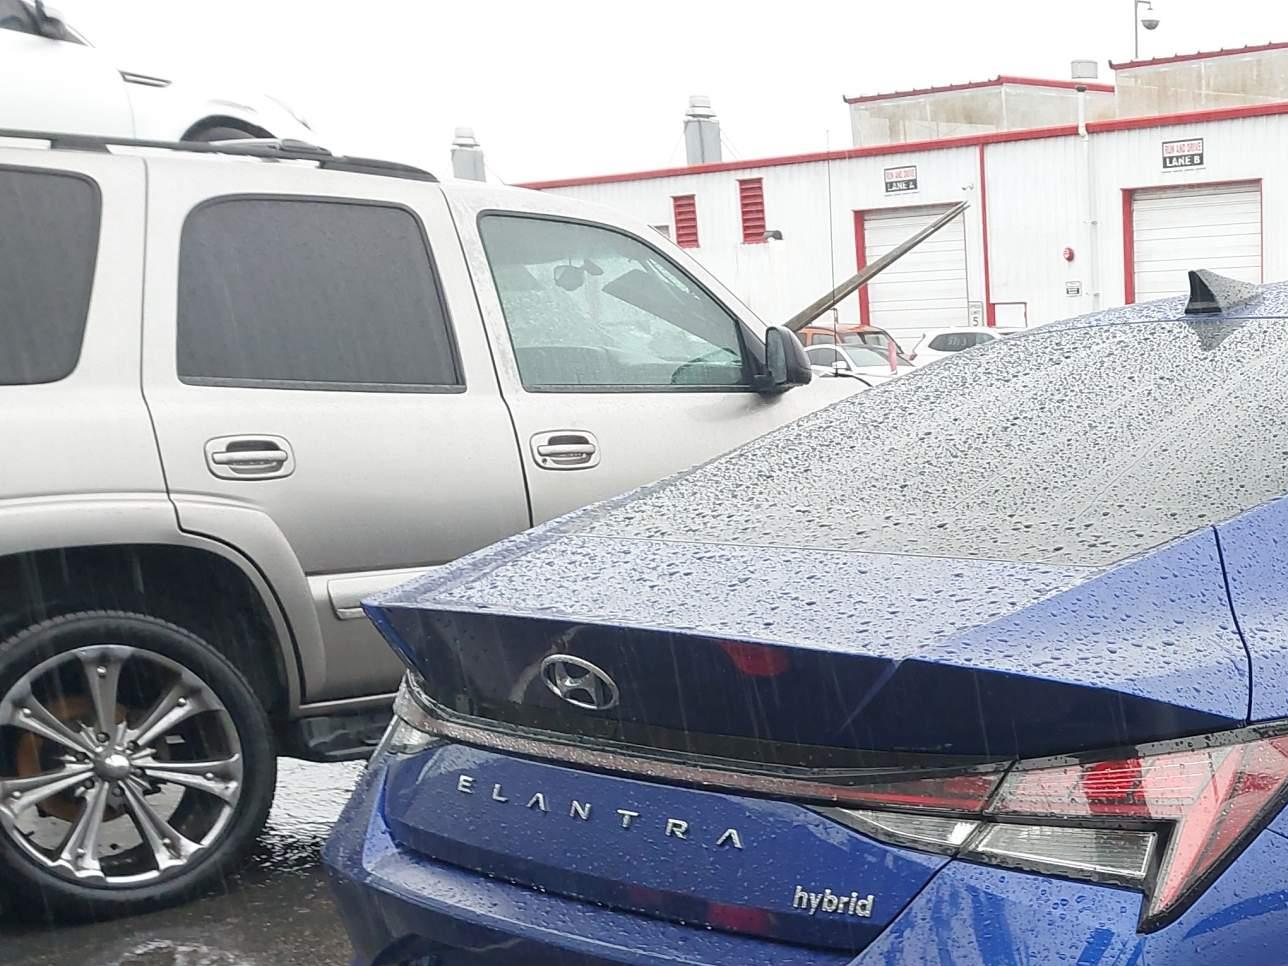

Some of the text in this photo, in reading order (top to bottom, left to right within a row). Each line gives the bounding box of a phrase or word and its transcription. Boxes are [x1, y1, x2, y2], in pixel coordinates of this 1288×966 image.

[1166, 155, 1201, 167] LANE B
[972, 316, 979, 327] 5
[457, 774, 743, 849] ELANTRA
[793, 885, 875, 918] hybrid
